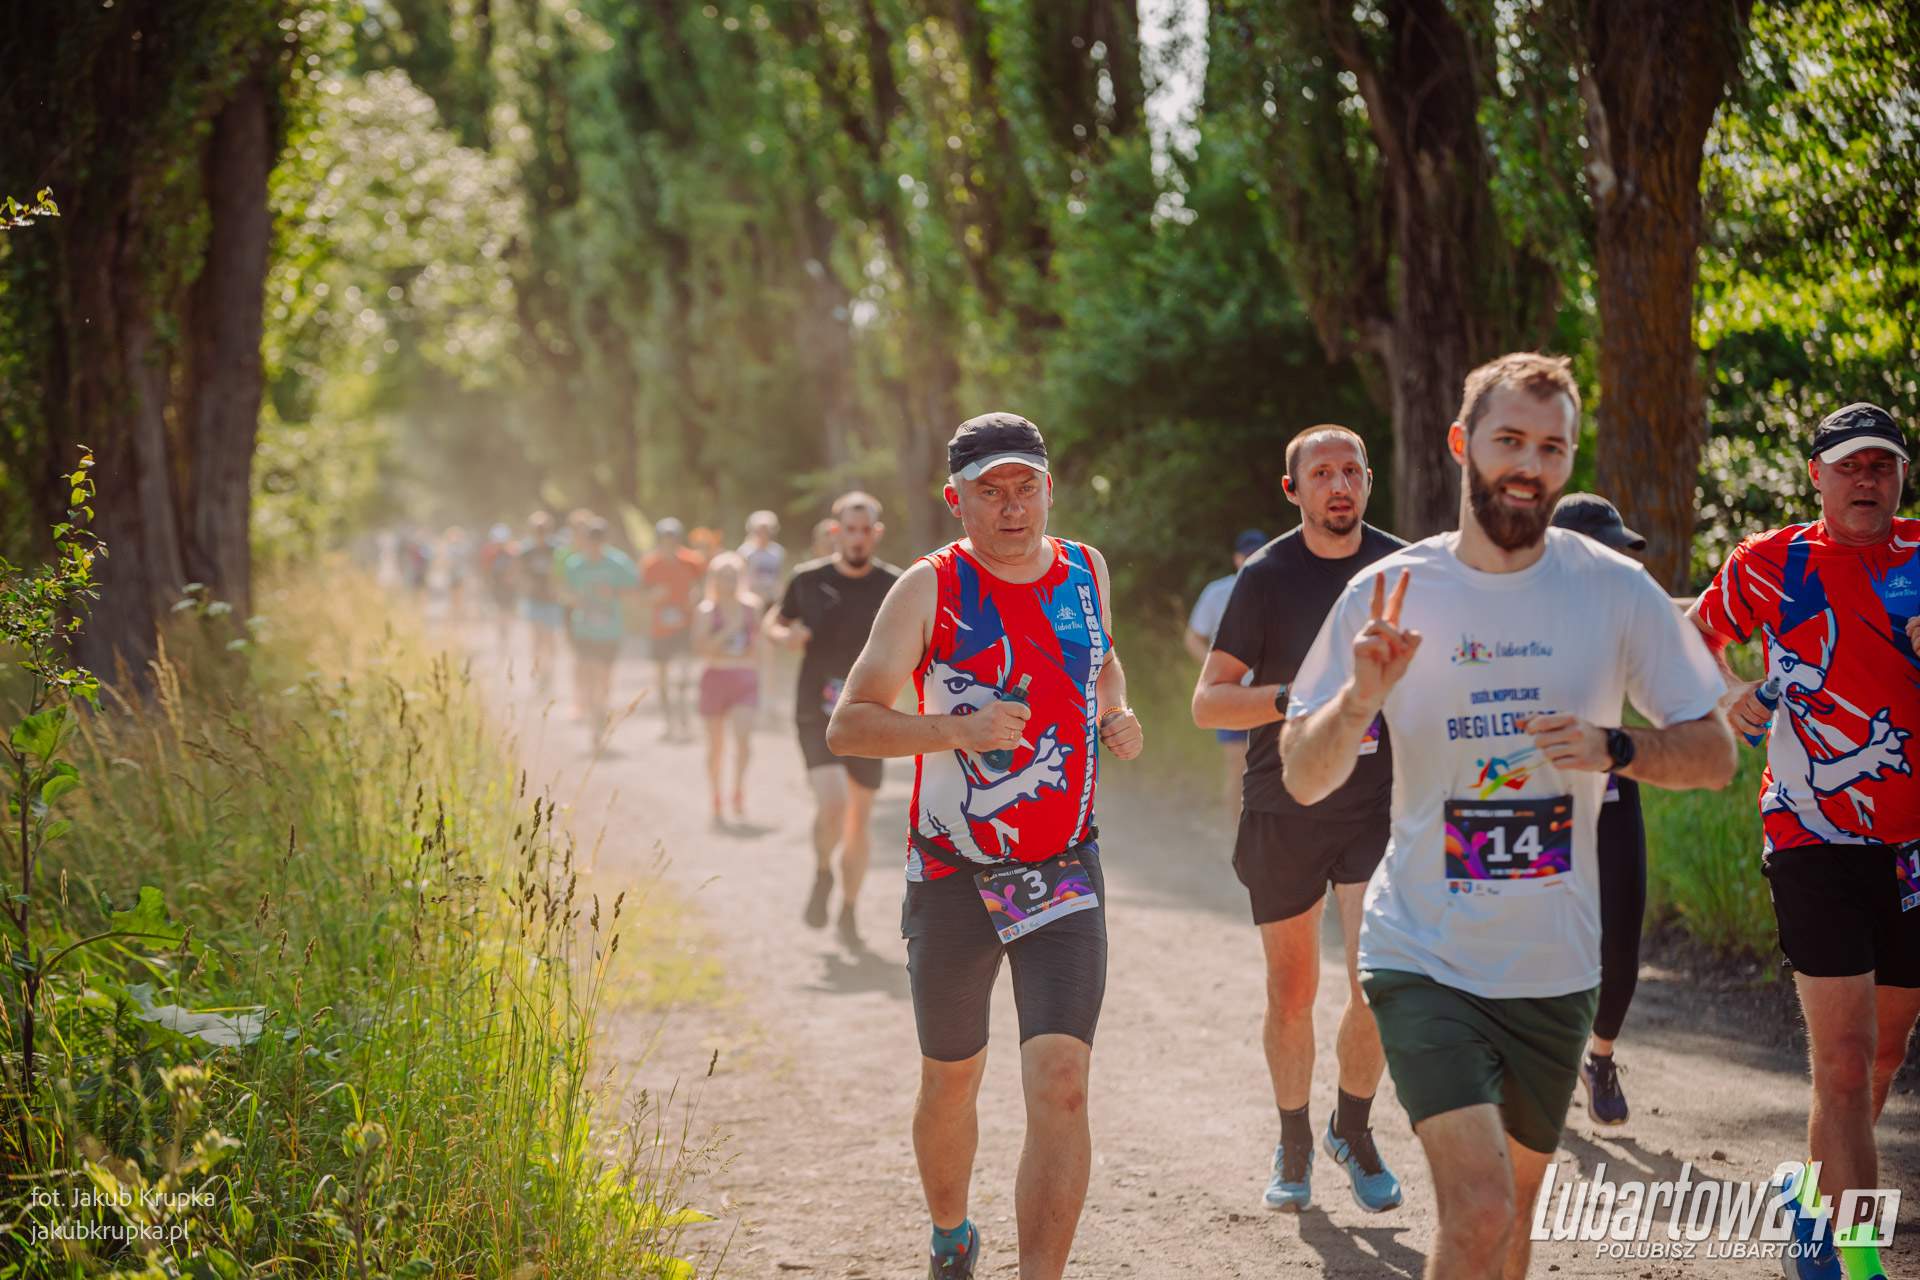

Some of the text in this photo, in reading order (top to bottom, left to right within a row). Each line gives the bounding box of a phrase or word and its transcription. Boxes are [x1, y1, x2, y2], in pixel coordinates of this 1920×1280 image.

[1447, 715, 1489, 741] BIEGI
[1486, 825, 1543, 862] 14
[1022, 869, 1048, 900] 3
